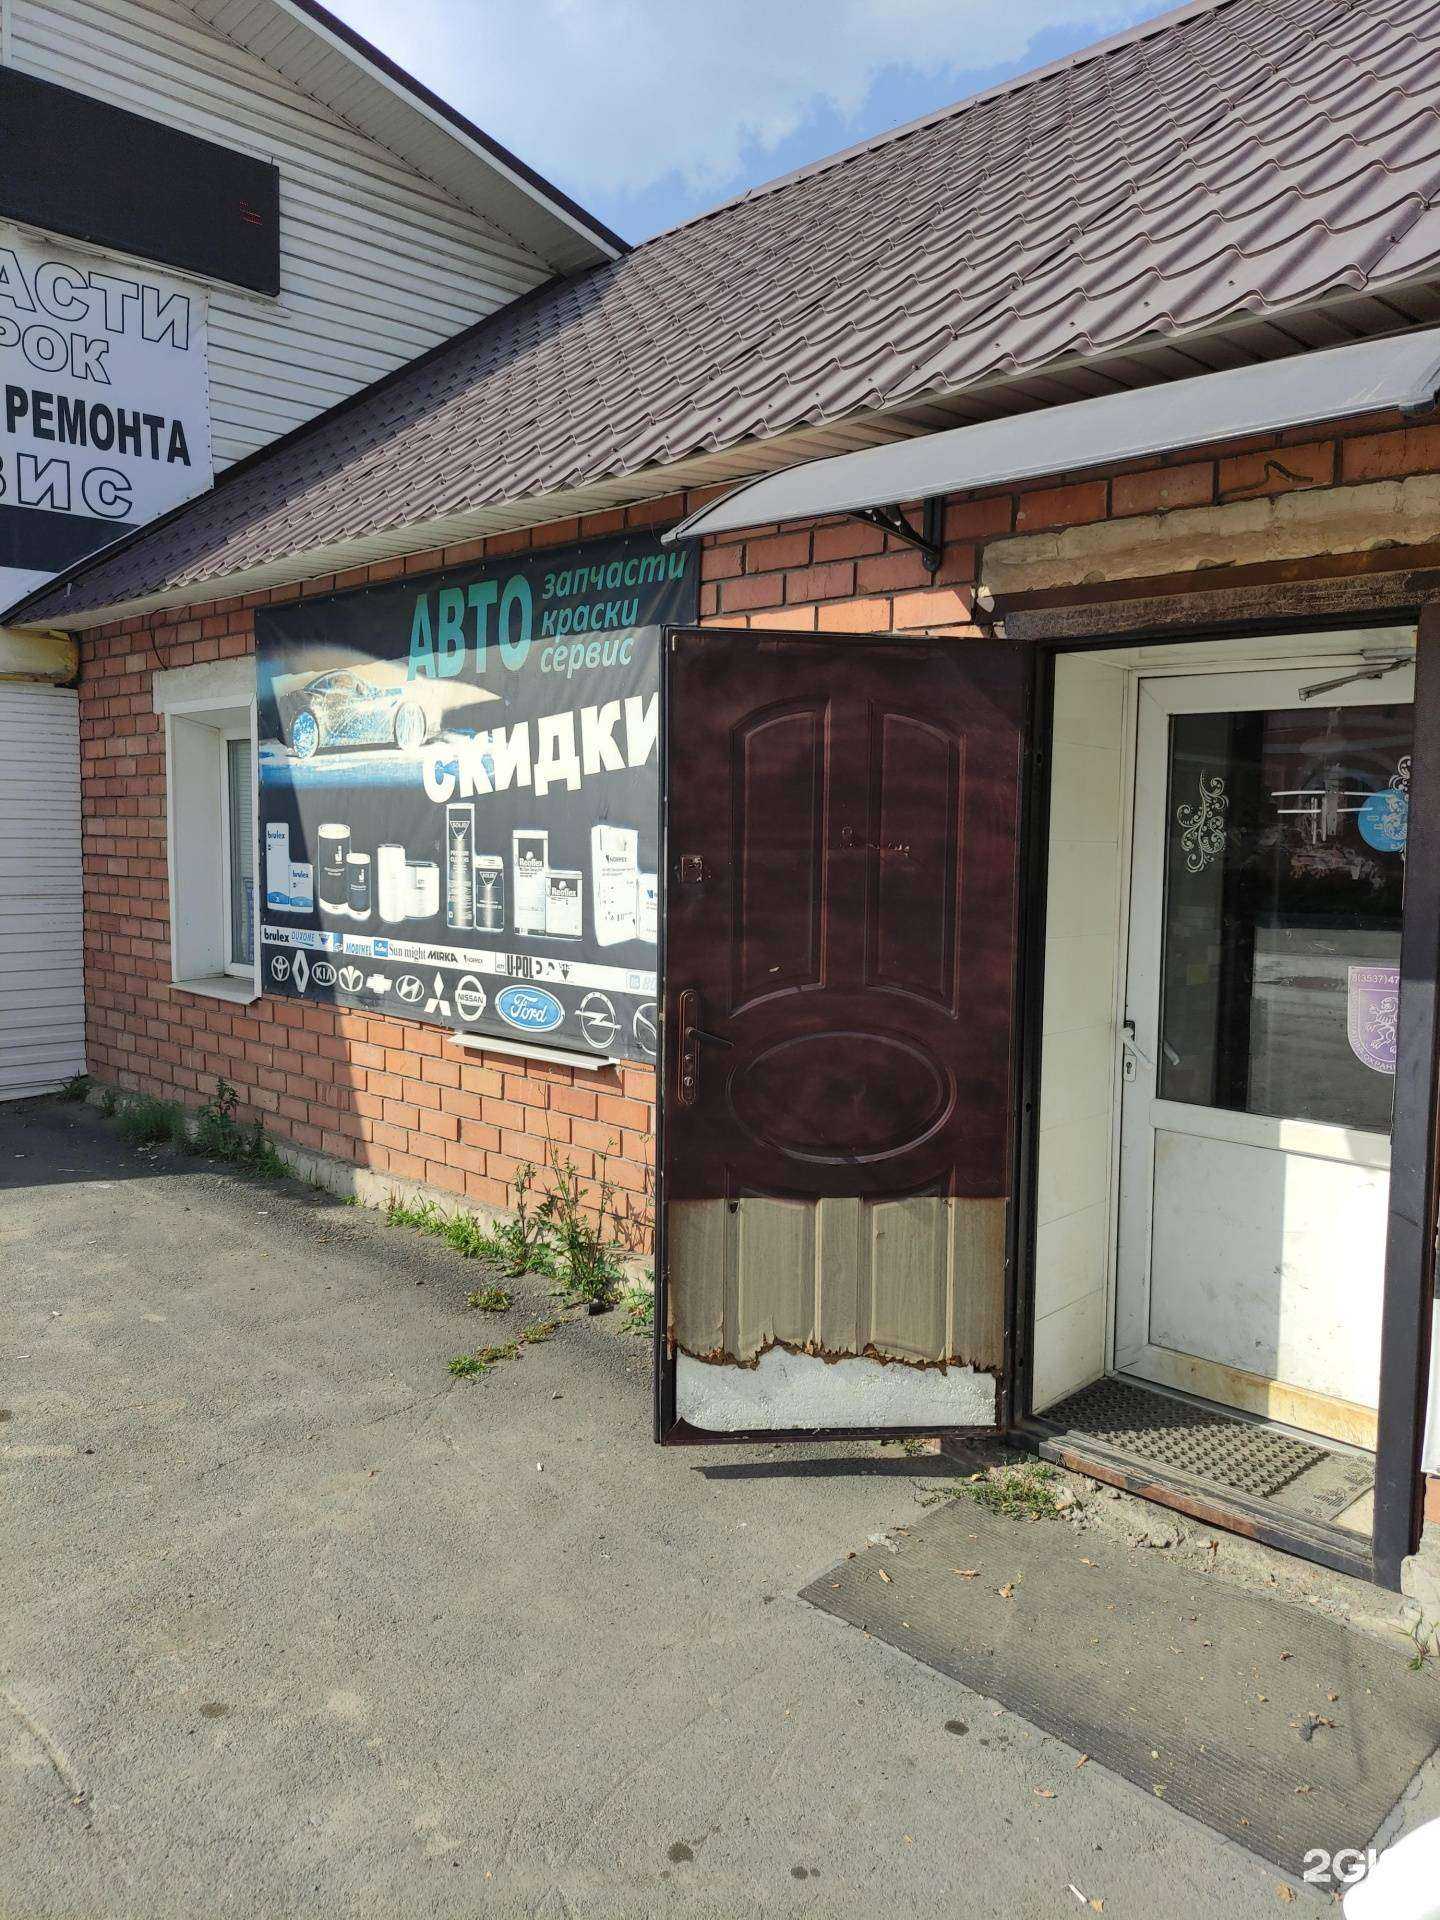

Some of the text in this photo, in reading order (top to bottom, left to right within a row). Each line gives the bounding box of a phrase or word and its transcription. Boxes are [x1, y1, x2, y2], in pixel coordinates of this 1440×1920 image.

[6, 384, 191, 467] РЕМОНТА
[0, 452, 133, 519] ИС
[542, 549, 689, 601] запчасти
[406, 574, 533, 681] АВТО
[541, 594, 640, 643] краски
[540, 634, 635, 679] сервис
[263, 927, 290, 943] brulex
[389, 945, 403, 957] Sun
[315, 966, 333, 980] KIA
[427, 950, 458, 963] MIRKA
[458, 993, 484, 1004] NISSAN
[510, 993, 548, 1023] Ford
